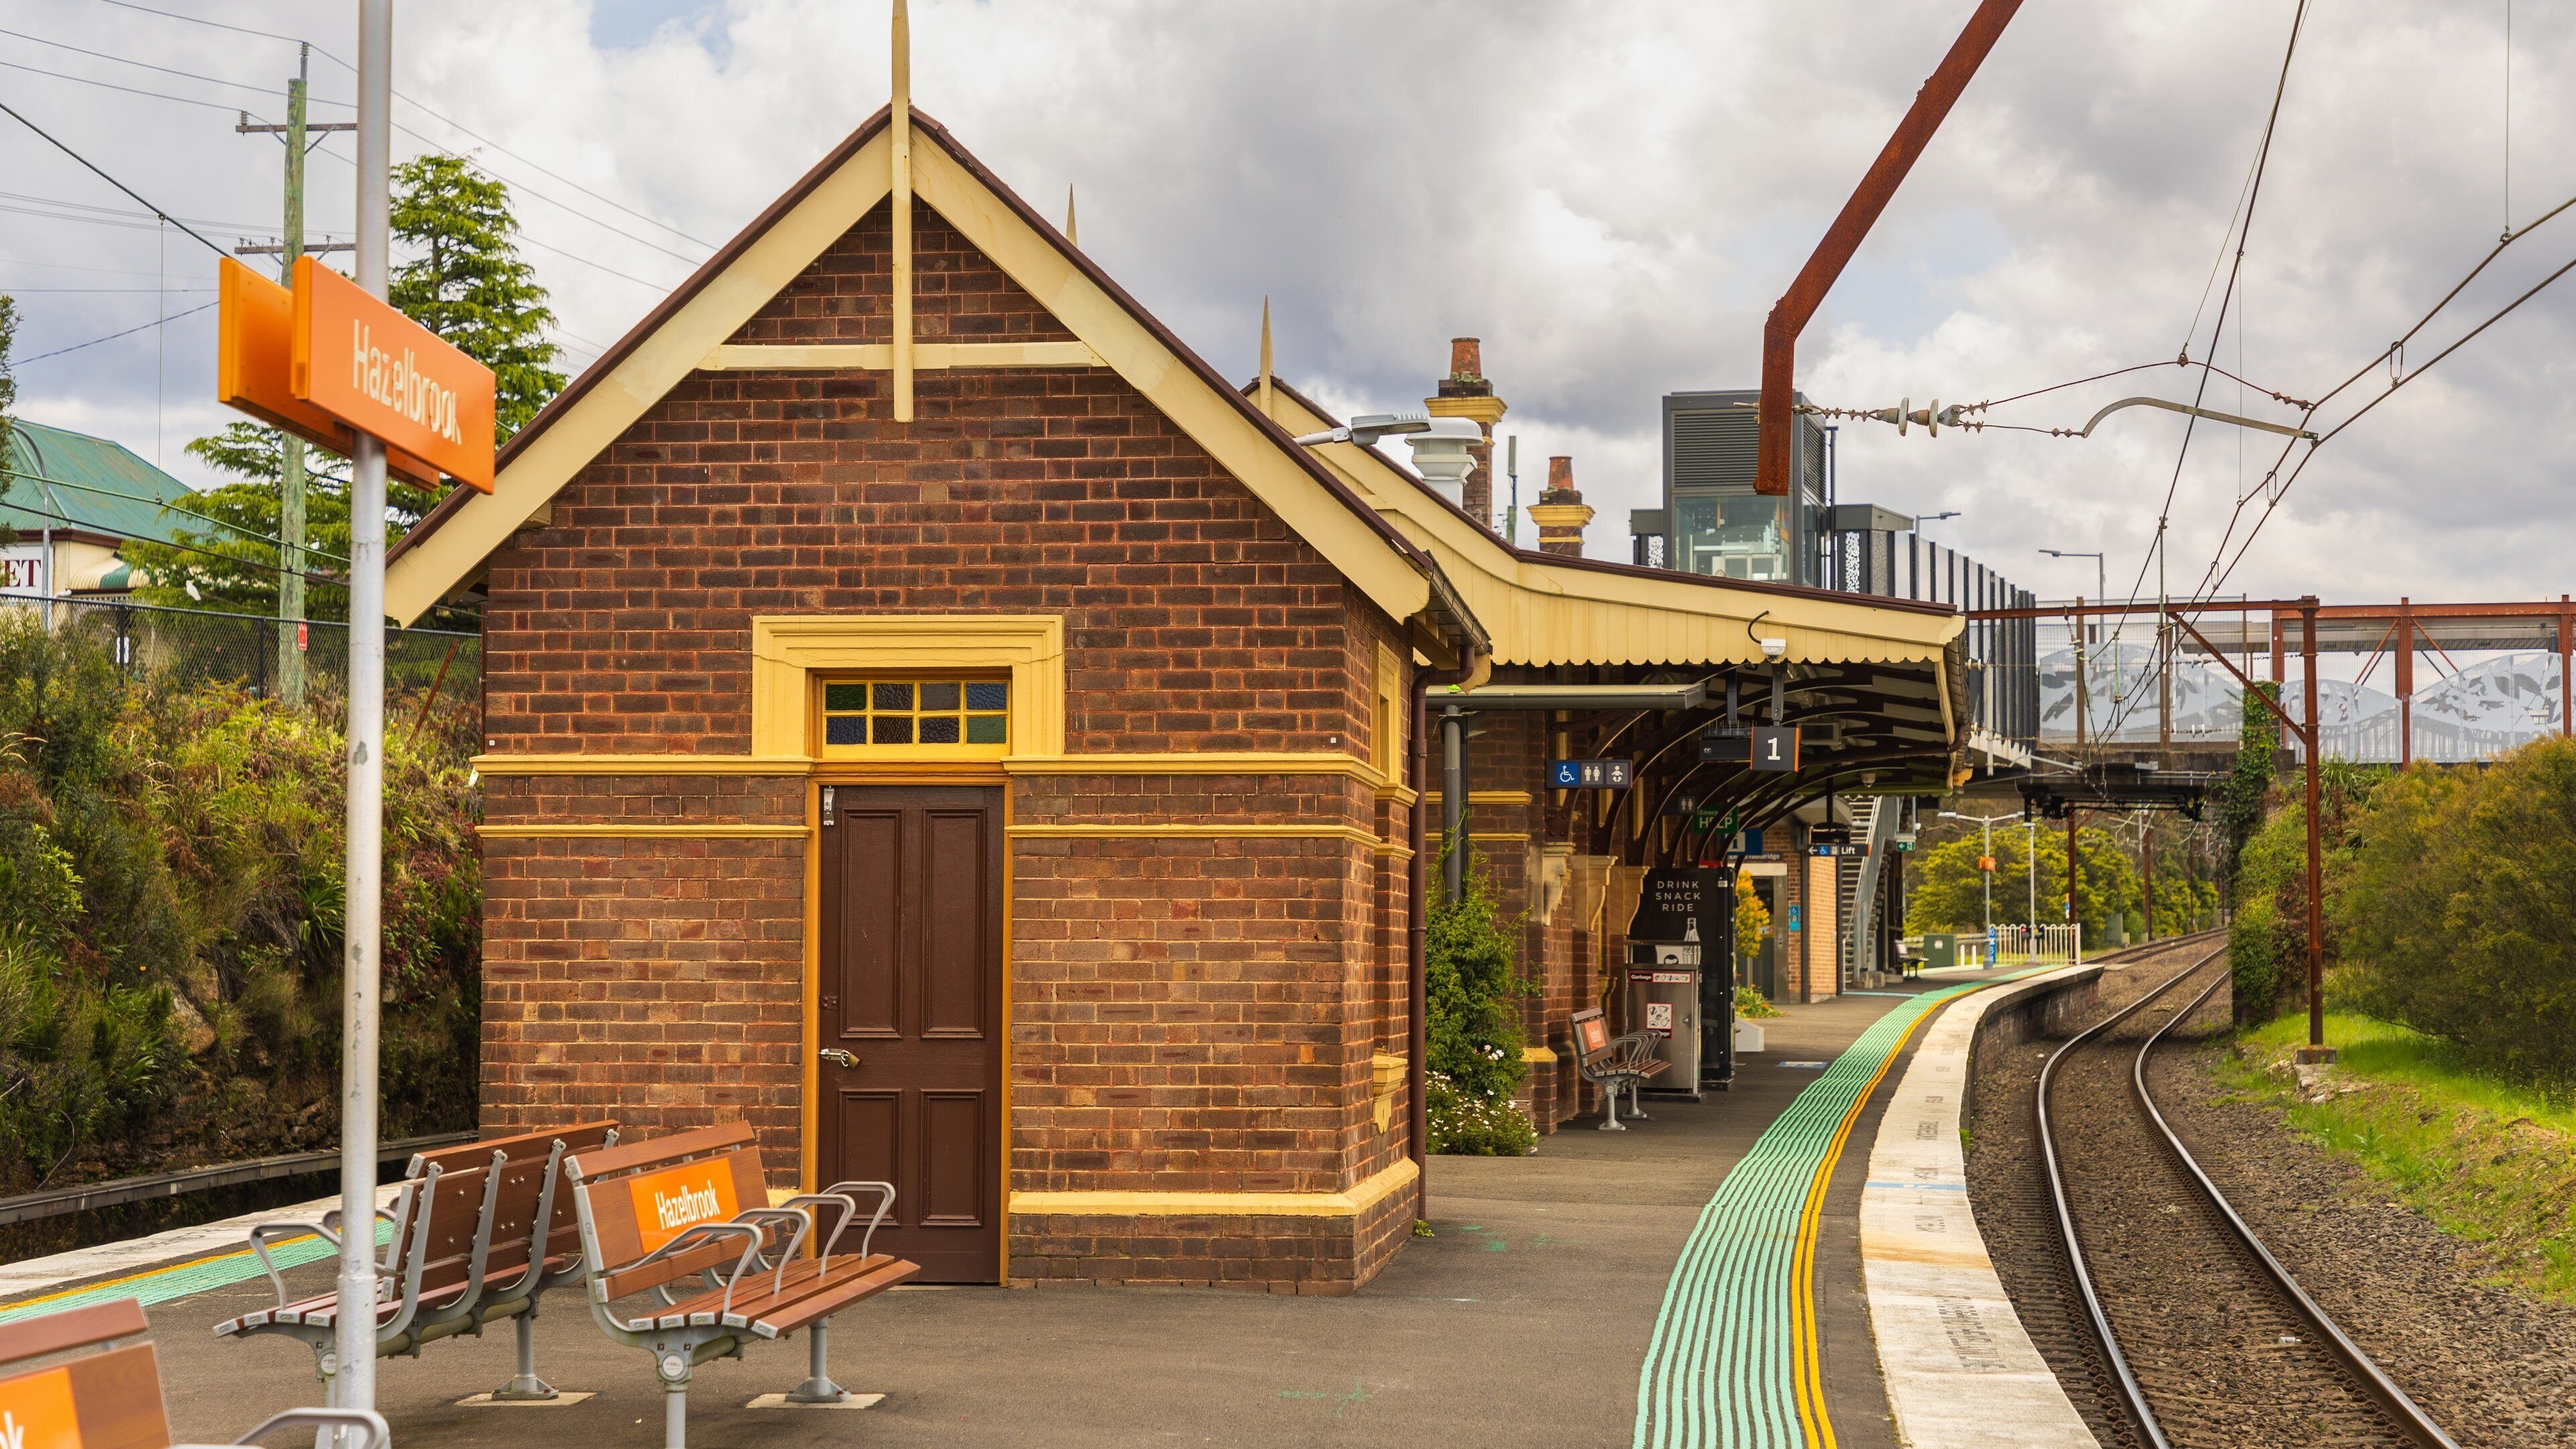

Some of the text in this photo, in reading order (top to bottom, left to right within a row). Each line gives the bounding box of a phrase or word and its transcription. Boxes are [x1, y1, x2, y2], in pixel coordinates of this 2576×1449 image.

[354, 319, 462, 445] Hazelbrook
[1768, 737, 1780, 760] 1
[1841, 847, 1856, 855] Lift
[1657, 881, 1699, 889] DRINK
[1656, 892, 1701, 900] SNACK
[1662, 904, 1694, 912] RIDE
[655, 1179, 721, 1230] Hazelbrook
